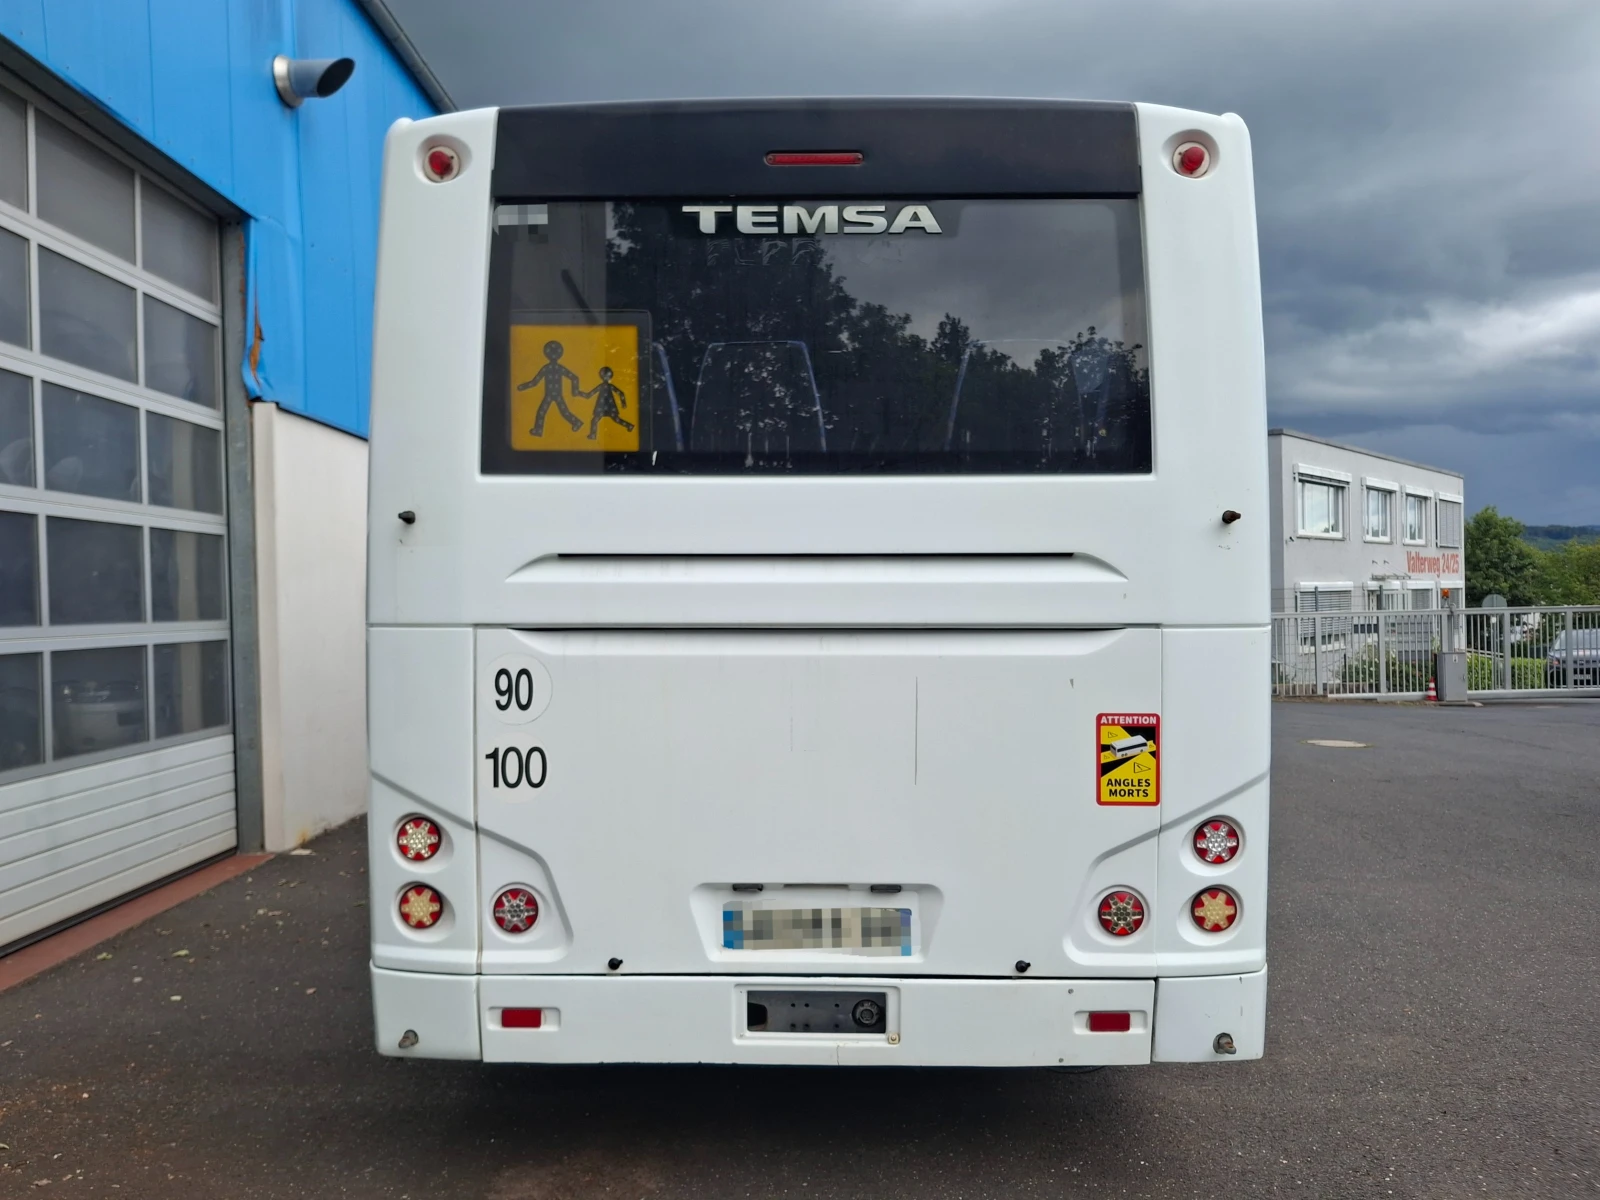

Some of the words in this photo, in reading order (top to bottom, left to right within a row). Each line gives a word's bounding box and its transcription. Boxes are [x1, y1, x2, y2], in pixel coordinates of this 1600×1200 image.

[682, 205, 942, 234] TEMSA
[1406, 551, 1440, 578] Valterweg
[1442, 553, 1459, 574] 24/25
[494, 668, 533, 711] 90
[1100, 716, 1156, 724] ATTENTION
[485, 746, 547, 789] 100
[1106, 778, 1151, 787] ANGLES
[1109, 788, 1149, 798] MORTS
